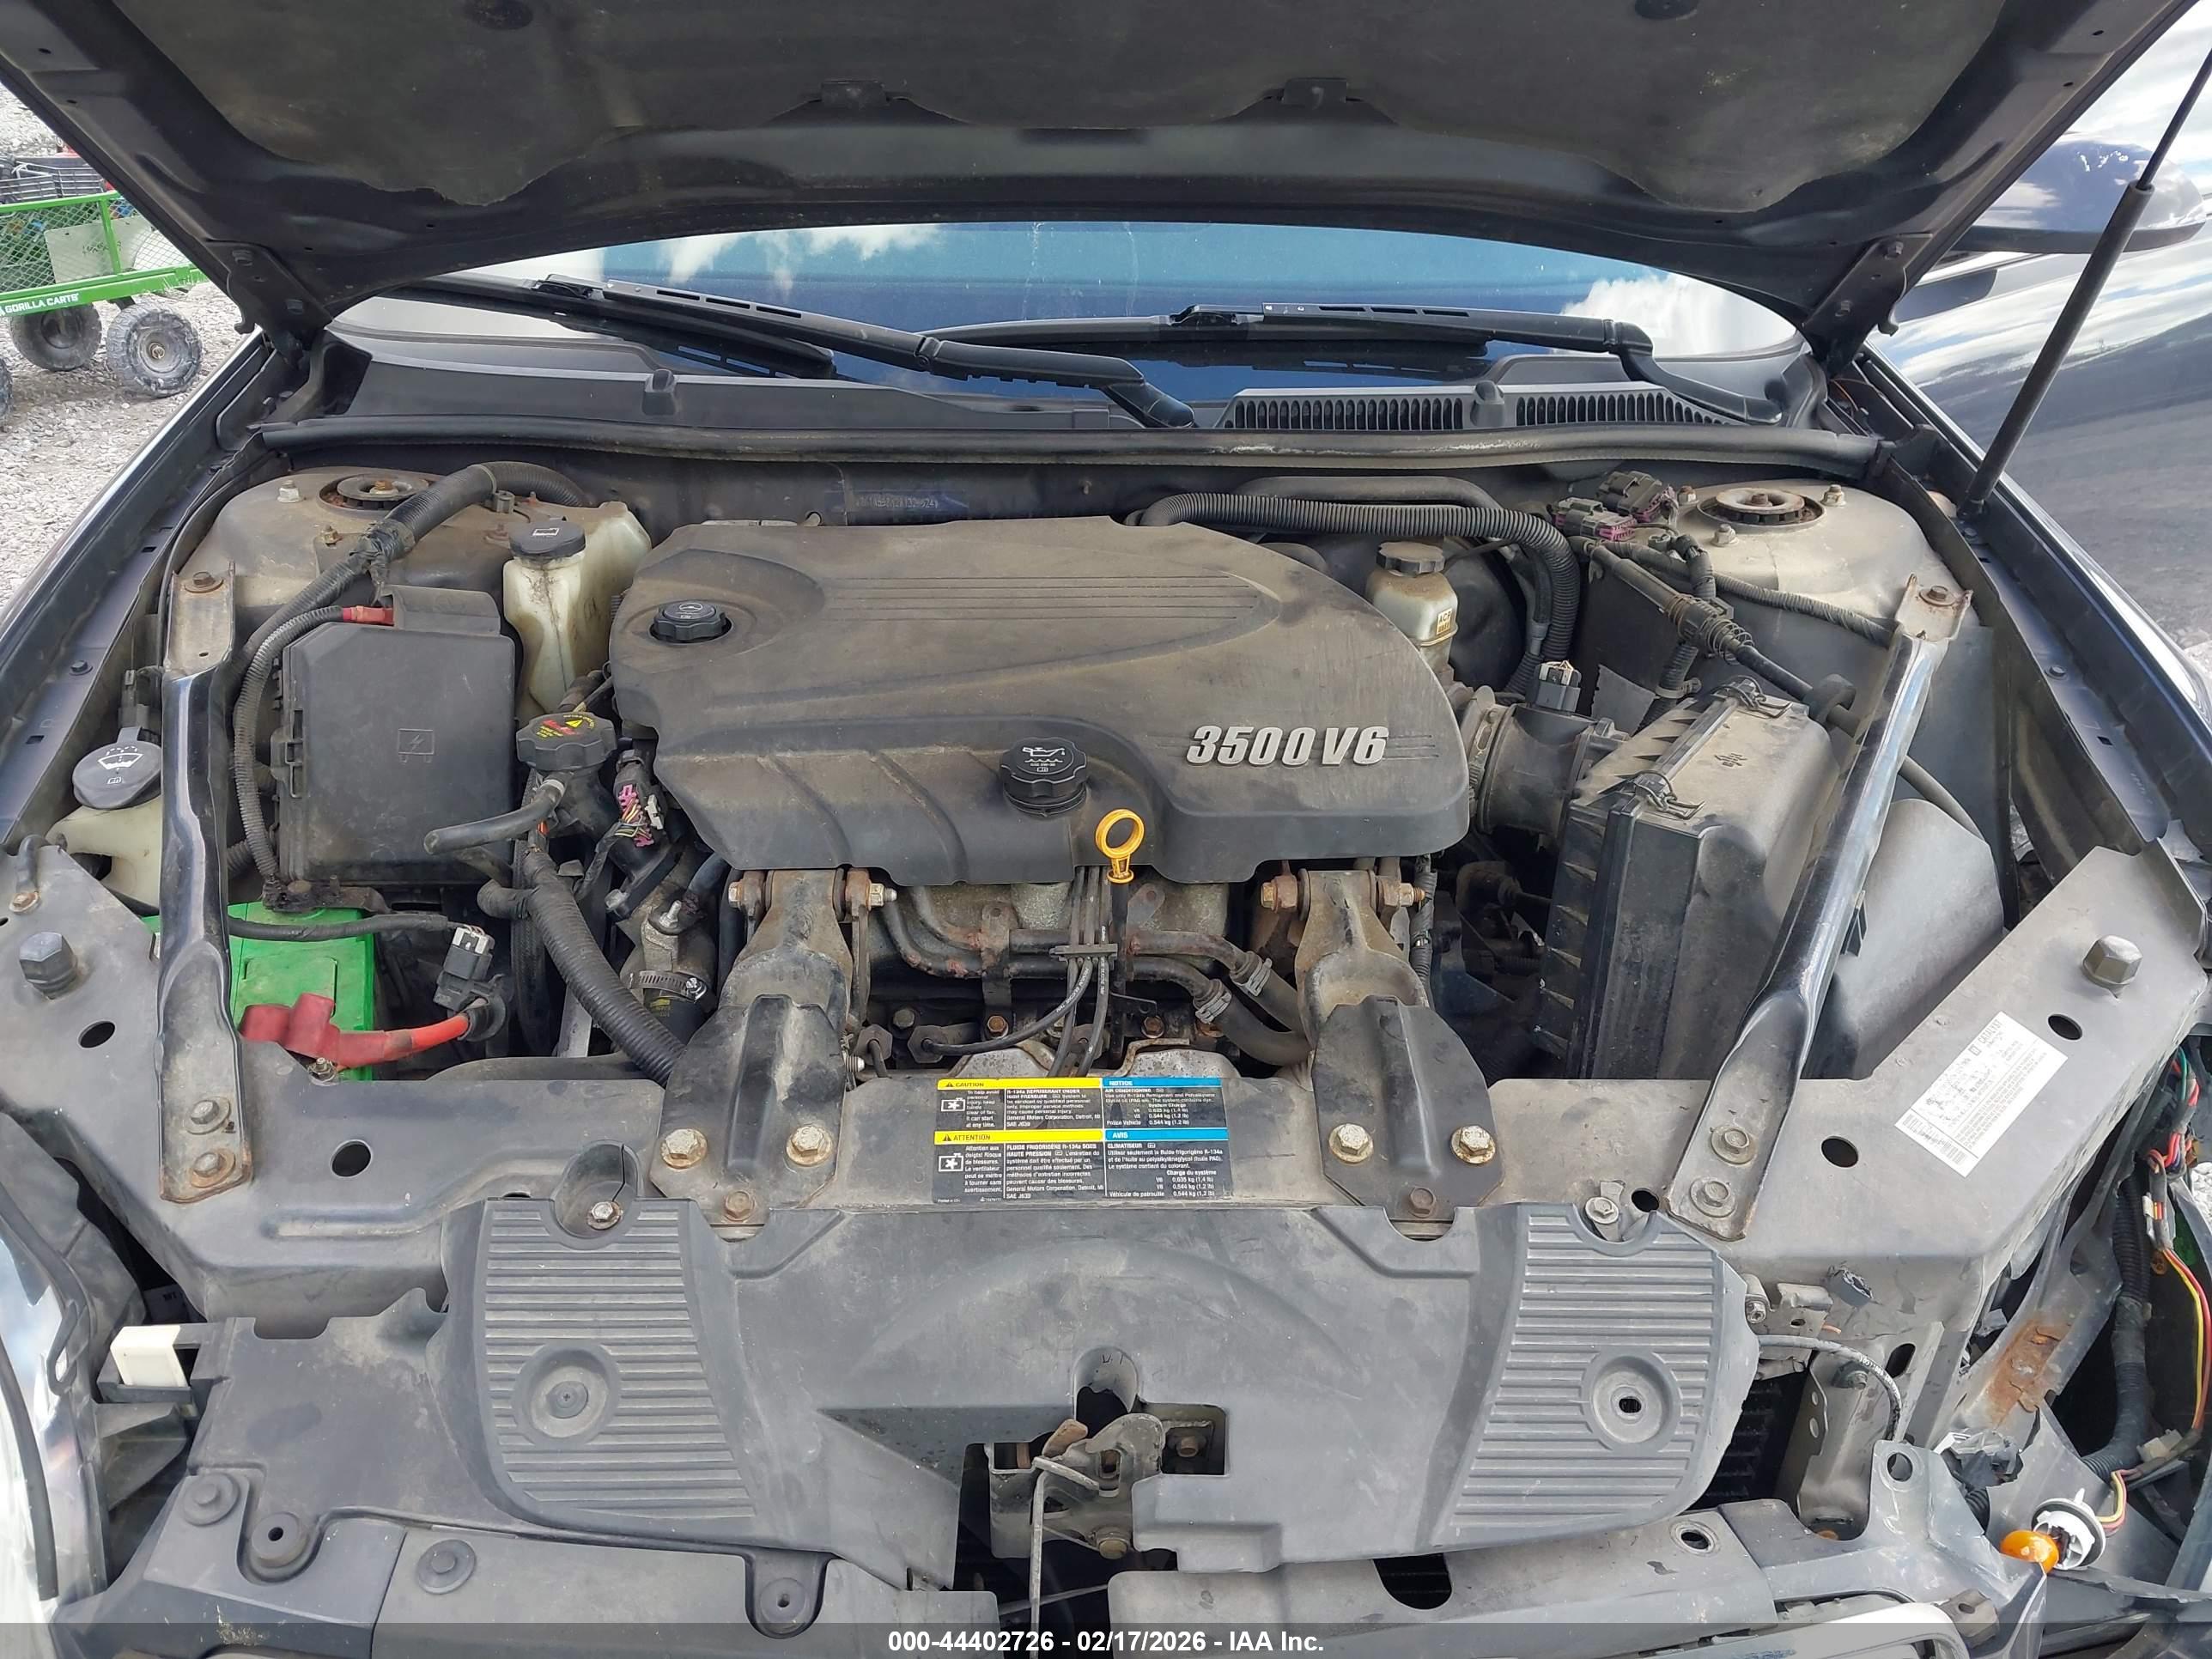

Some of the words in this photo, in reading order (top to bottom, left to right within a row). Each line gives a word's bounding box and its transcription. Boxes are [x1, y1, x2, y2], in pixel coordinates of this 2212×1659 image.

[5, 301, 46, 313] GORILLA
[46, 293, 78, 306] CARTS
[1186, 726, 1316, 765] 3500
[1322, 726, 1389, 765] V6
[1978, 1018, 2002, 1044] CATALYST
